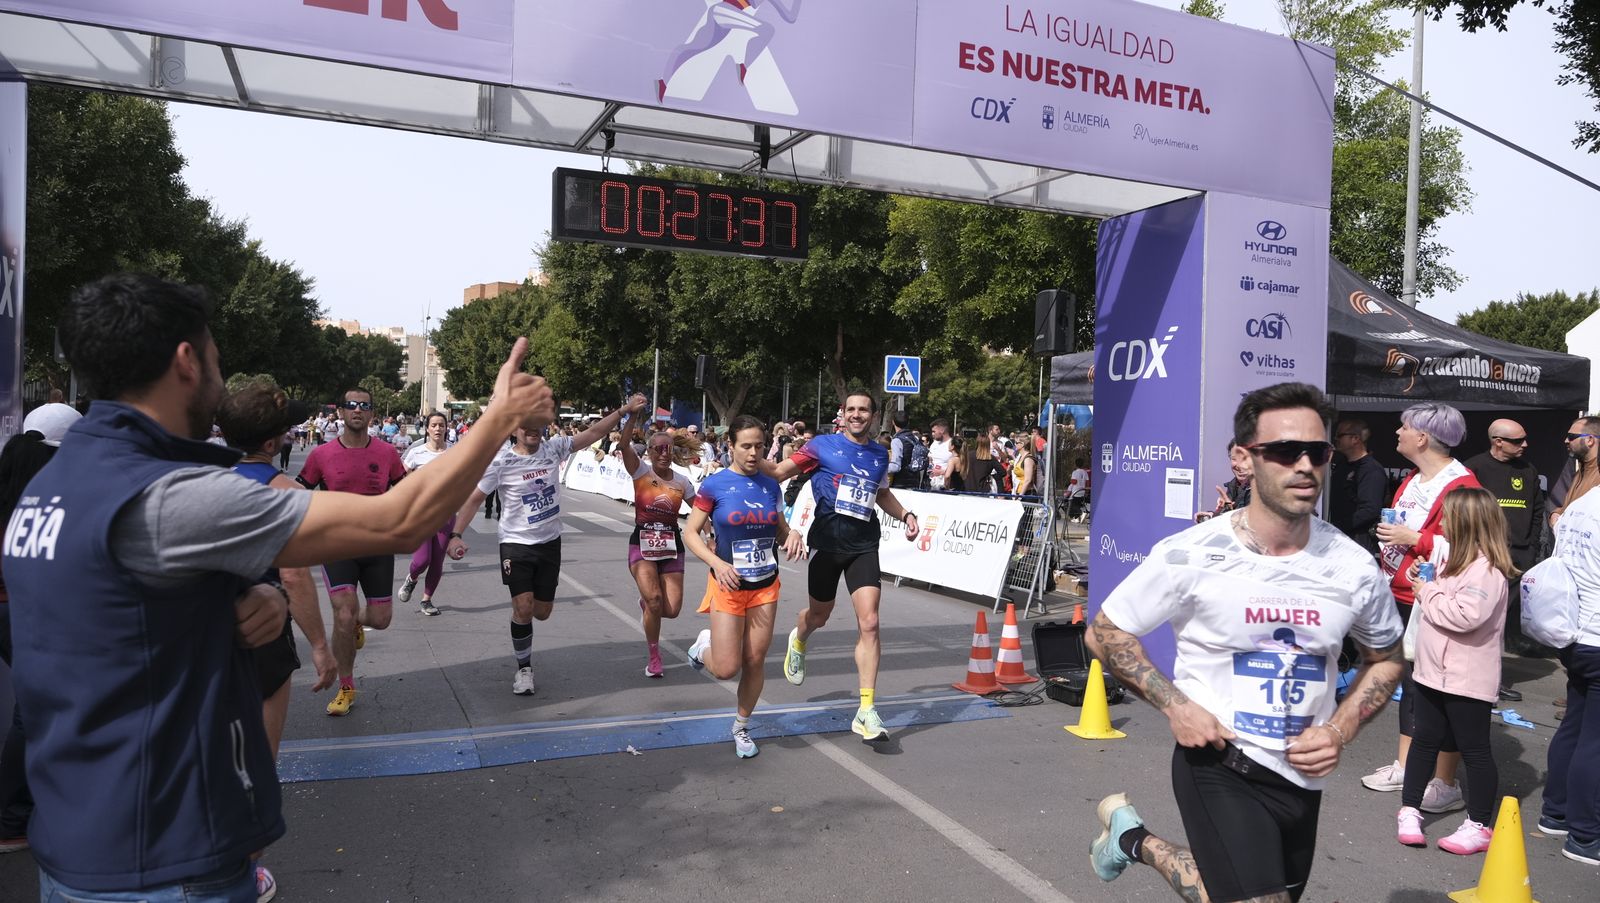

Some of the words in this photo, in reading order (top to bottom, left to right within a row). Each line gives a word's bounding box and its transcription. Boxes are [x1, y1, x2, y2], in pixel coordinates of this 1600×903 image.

[1005, 5, 1037, 37] LA
[1047, 14, 1174, 64] IGUALDAD
[959, 41, 995, 73] ES
[1002, 49, 1129, 101] NUESTRA
[1134, 77, 1211, 115] META.
[971, 97, 1016, 124] CDX
[1063, 110, 1110, 129] ALMERÍA
[1063, 123, 1088, 135] CIUDAD
[601, 180, 797, 249] 00:27:37
[1244, 240, 1298, 257] HYUNDAI
[1257, 279, 1300, 294] cajamar
[1246, 318, 1284, 340] CASI
[1108, 326, 1179, 382] CDX
[1257, 354, 1295, 369] vithas
[1122, 442, 1183, 462] ALMERÍA
[522, 469, 548, 481] MUJER
[1122, 462, 1151, 473] CIUDAD
[529, 495, 555, 512] 2045
[849, 488, 870, 502] 191
[944, 519, 1009, 545] ALMERÍA
[648, 539, 668, 548] 924
[943, 539, 974, 556] CIUDAD
[745, 550, 766, 563] 190
[1248, 596, 1288, 606] CARRERA
[1290, 597, 1301, 607] DE
[1304, 598, 1316, 607] LA
[1245, 607, 1321, 626] MUJER
[1247, 661, 1275, 670] MUJER
